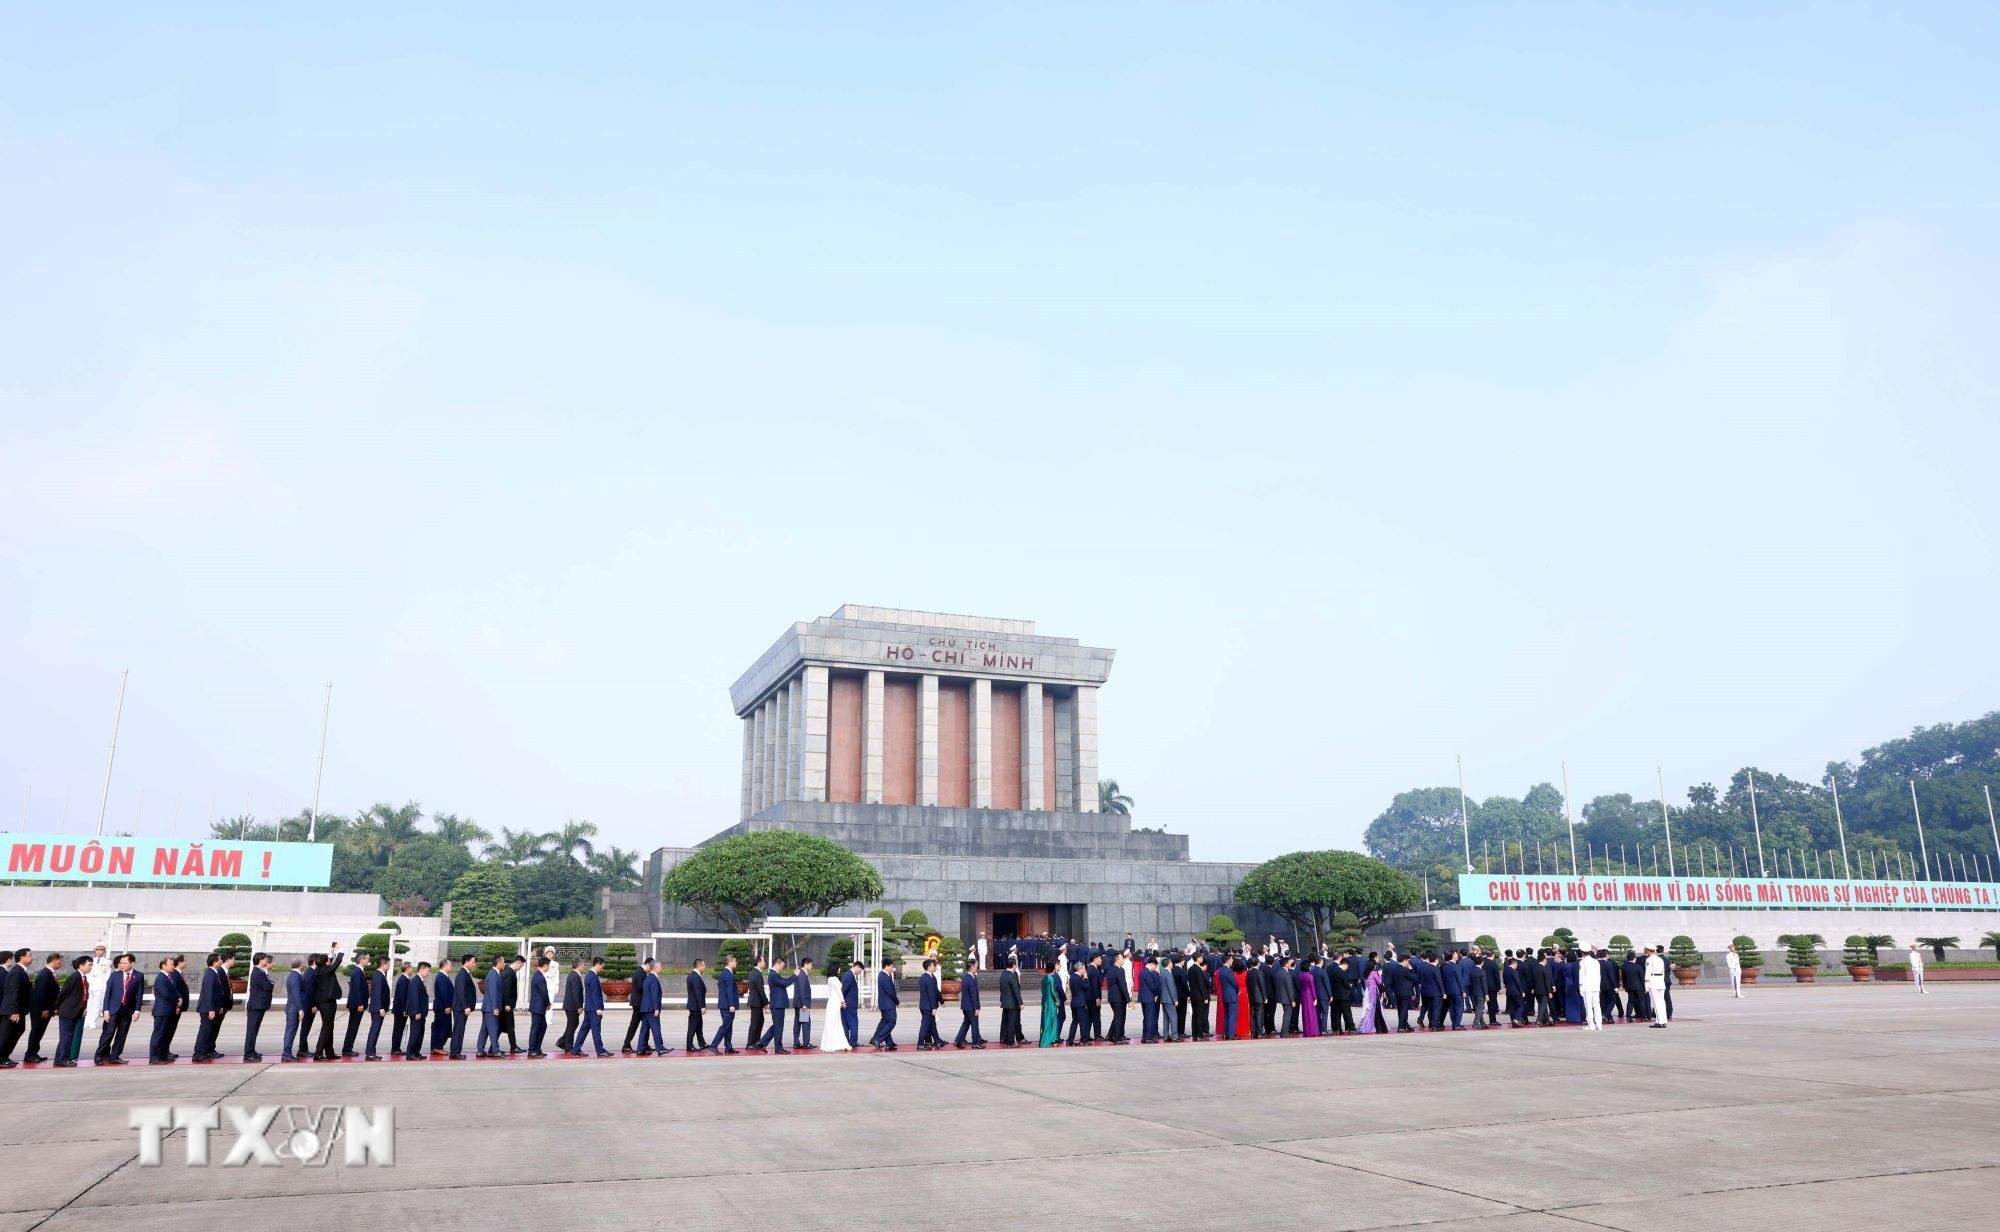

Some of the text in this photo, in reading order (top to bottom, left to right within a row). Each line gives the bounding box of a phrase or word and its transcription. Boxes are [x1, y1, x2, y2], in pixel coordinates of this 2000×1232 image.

[8, 840, 273, 879] MUÔN NĂM !
[1488, 875, 1521, 902] CHỦ
[1525, 881, 1562, 905] TỊCH
[1566, 876, 1588, 902] HỒ
[1592, 879, 1619, 902] CHÍ
[1623, 882, 1662, 902] MINH
[1667, 879, 1682, 902] VĨ
[1686, 883, 1710, 905] ĐẠI
[1715, 878, 1753, 903] SỐNG
[1756, 881, 1783, 903] MÃI
[1786, 884, 1830, 903] TRONG
[1833, 883, 1850, 906] SỰ
[1854, 882, 1899, 907] NGHIỆP
[1903, 882, 1928, 904] CỦA
[1931, 884, 1972, 905] CHÚNG
[1974, 887, 1990, 905] TA
